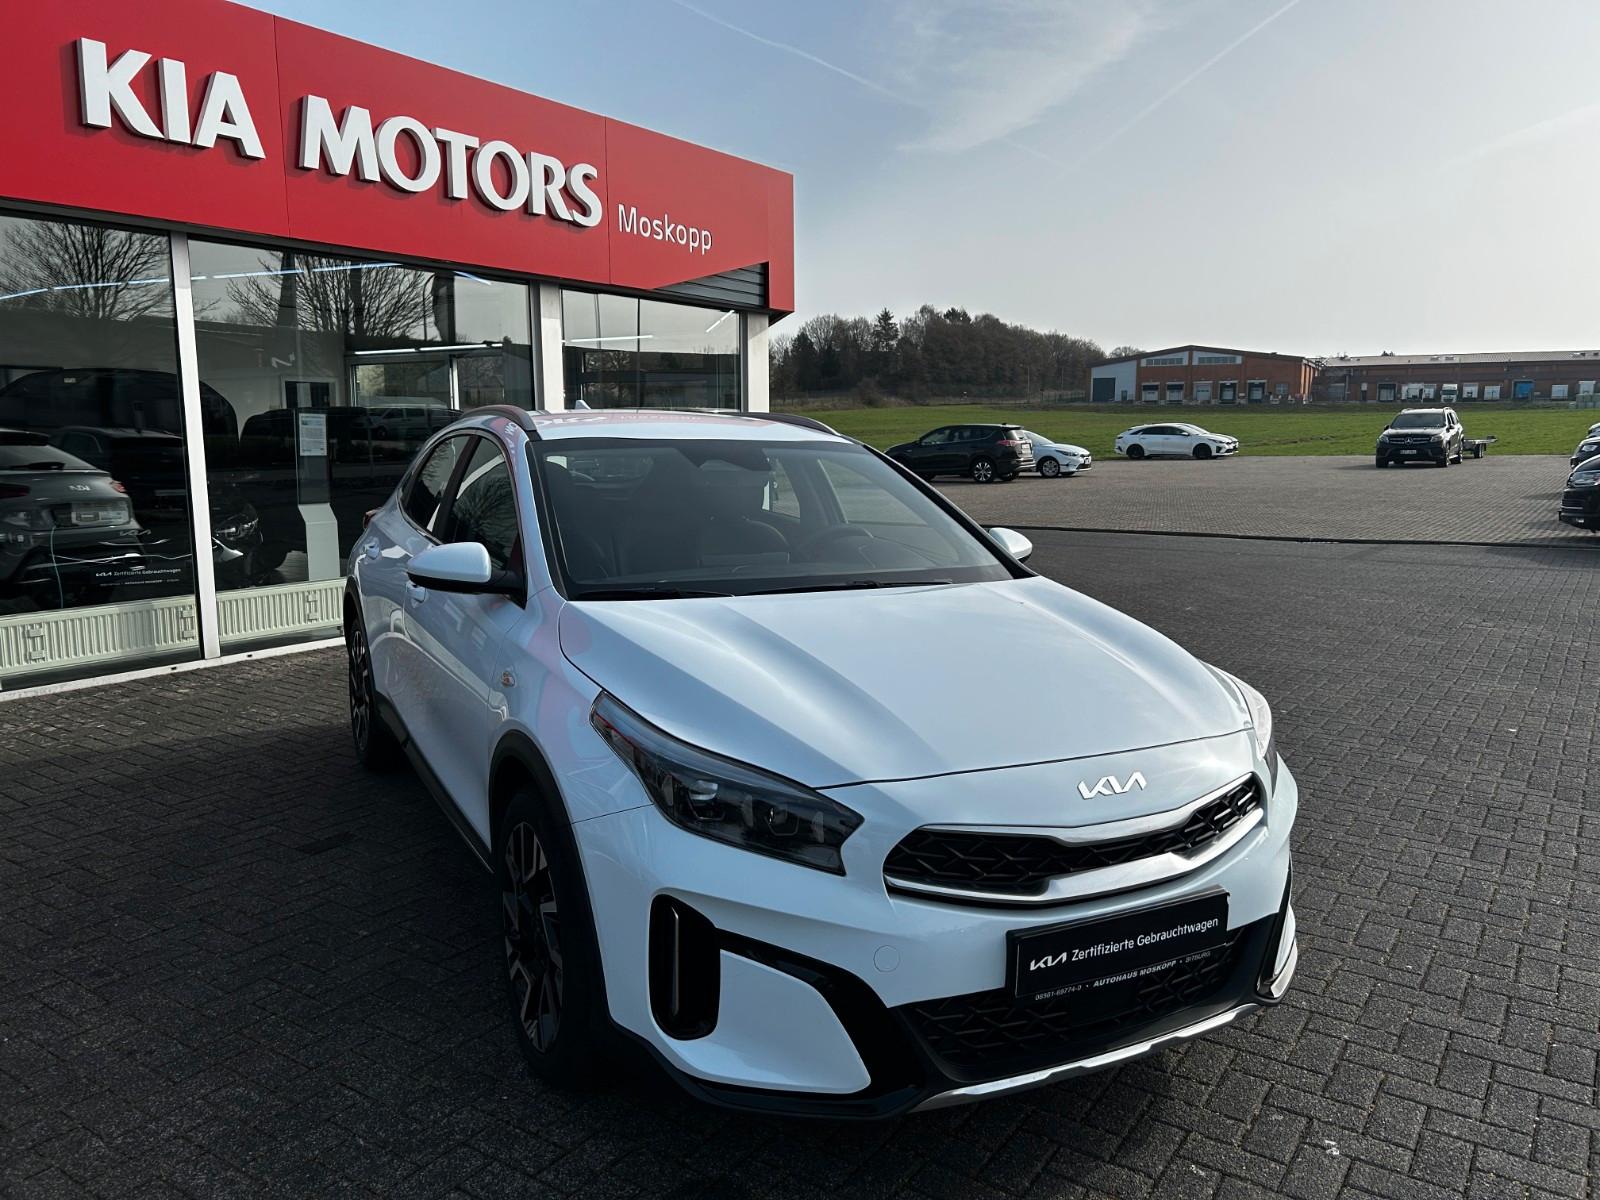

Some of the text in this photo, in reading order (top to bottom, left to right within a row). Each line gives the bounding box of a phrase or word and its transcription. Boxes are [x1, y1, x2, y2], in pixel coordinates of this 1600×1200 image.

[77, 37, 602, 228] KIA MOTORS
[617, 203, 713, 256] Moskopp
[1077, 771, 1147, 800] KIA
[1029, 917, 1219, 971] KIA Zertifizierte Gebrauchtwagen
[1093, 971, 1138, 988] AUTOHAUS
[1139, 960, 1177, 976] MOSKOPP
